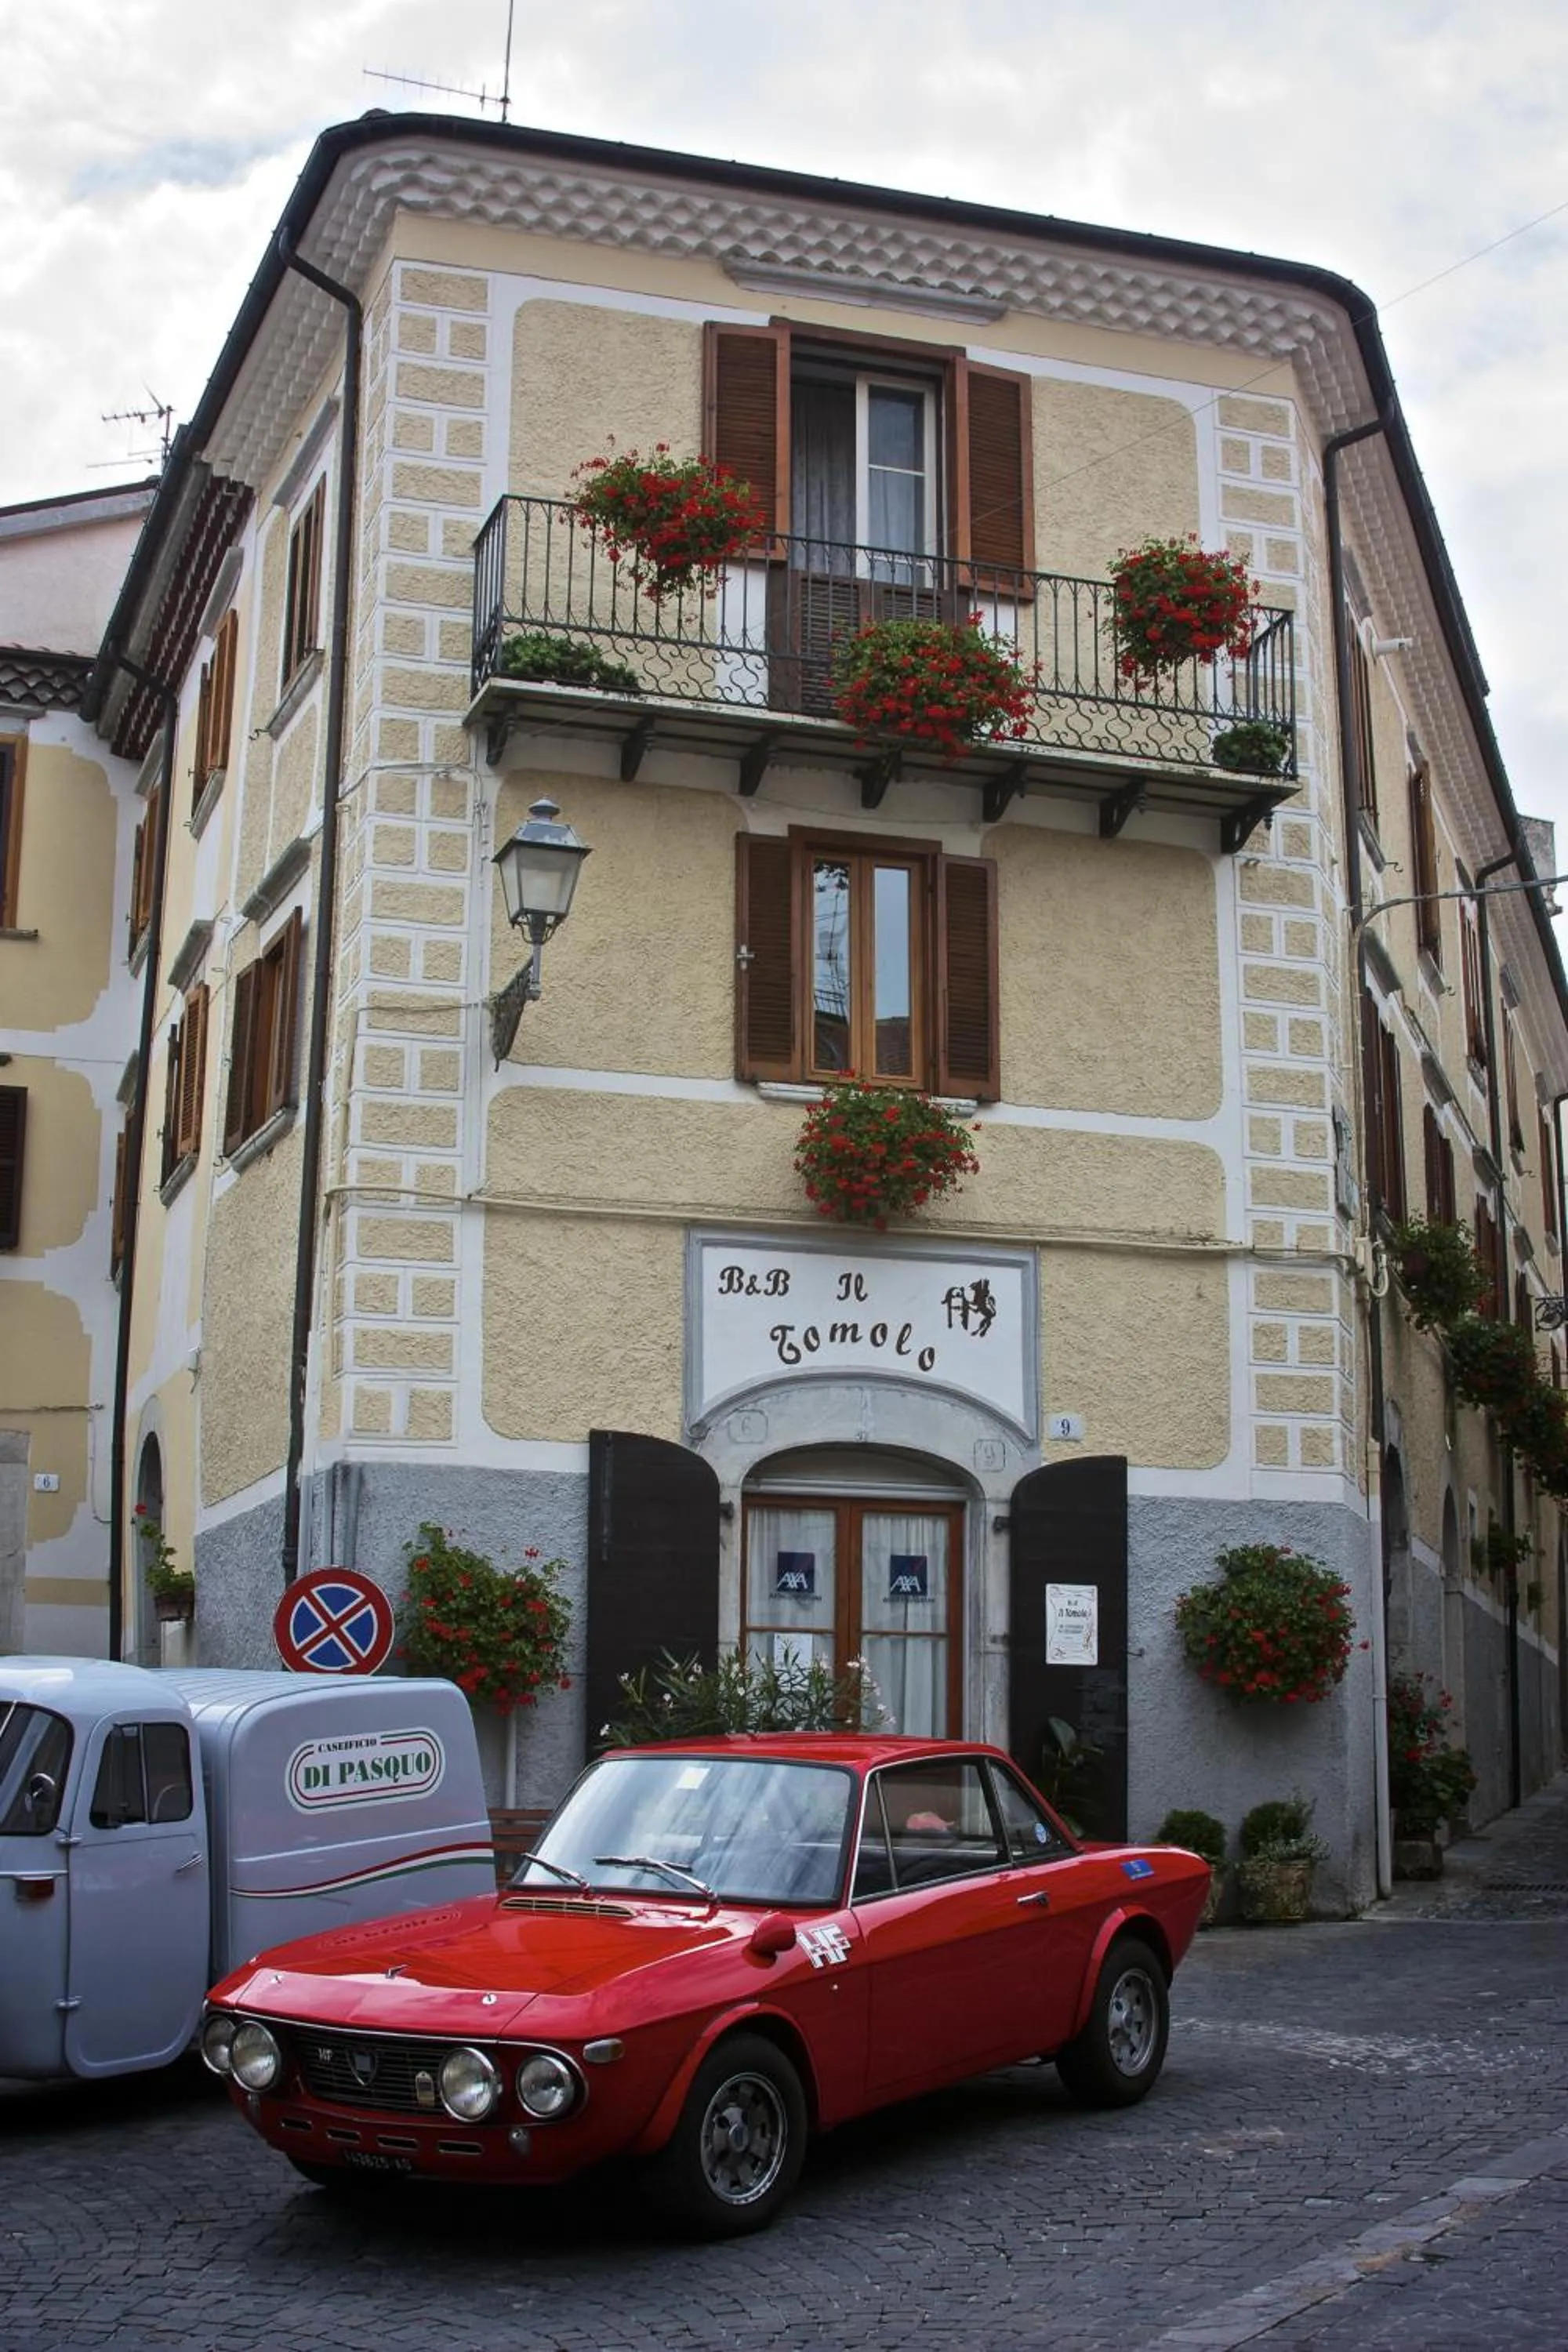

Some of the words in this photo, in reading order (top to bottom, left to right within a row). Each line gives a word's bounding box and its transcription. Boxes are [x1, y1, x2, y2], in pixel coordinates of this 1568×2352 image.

[719, 1266, 790, 1296] B&B
[837, 1272, 868, 1301] Il
[770, 1323, 935, 1371] Tomolo
[1061, 1418, 1070, 1436] 9
[43, 1475, 51, 1488] 6
[777, 1572, 808, 1589] AXA
[890, 1575, 921, 1592] AXA
[318, 1738, 376, 1753] CASEIFICIO
[304, 1765, 330, 1789] DI
[339, 1751, 431, 1785] PASQUO
[797, 1923, 851, 1968] HF
